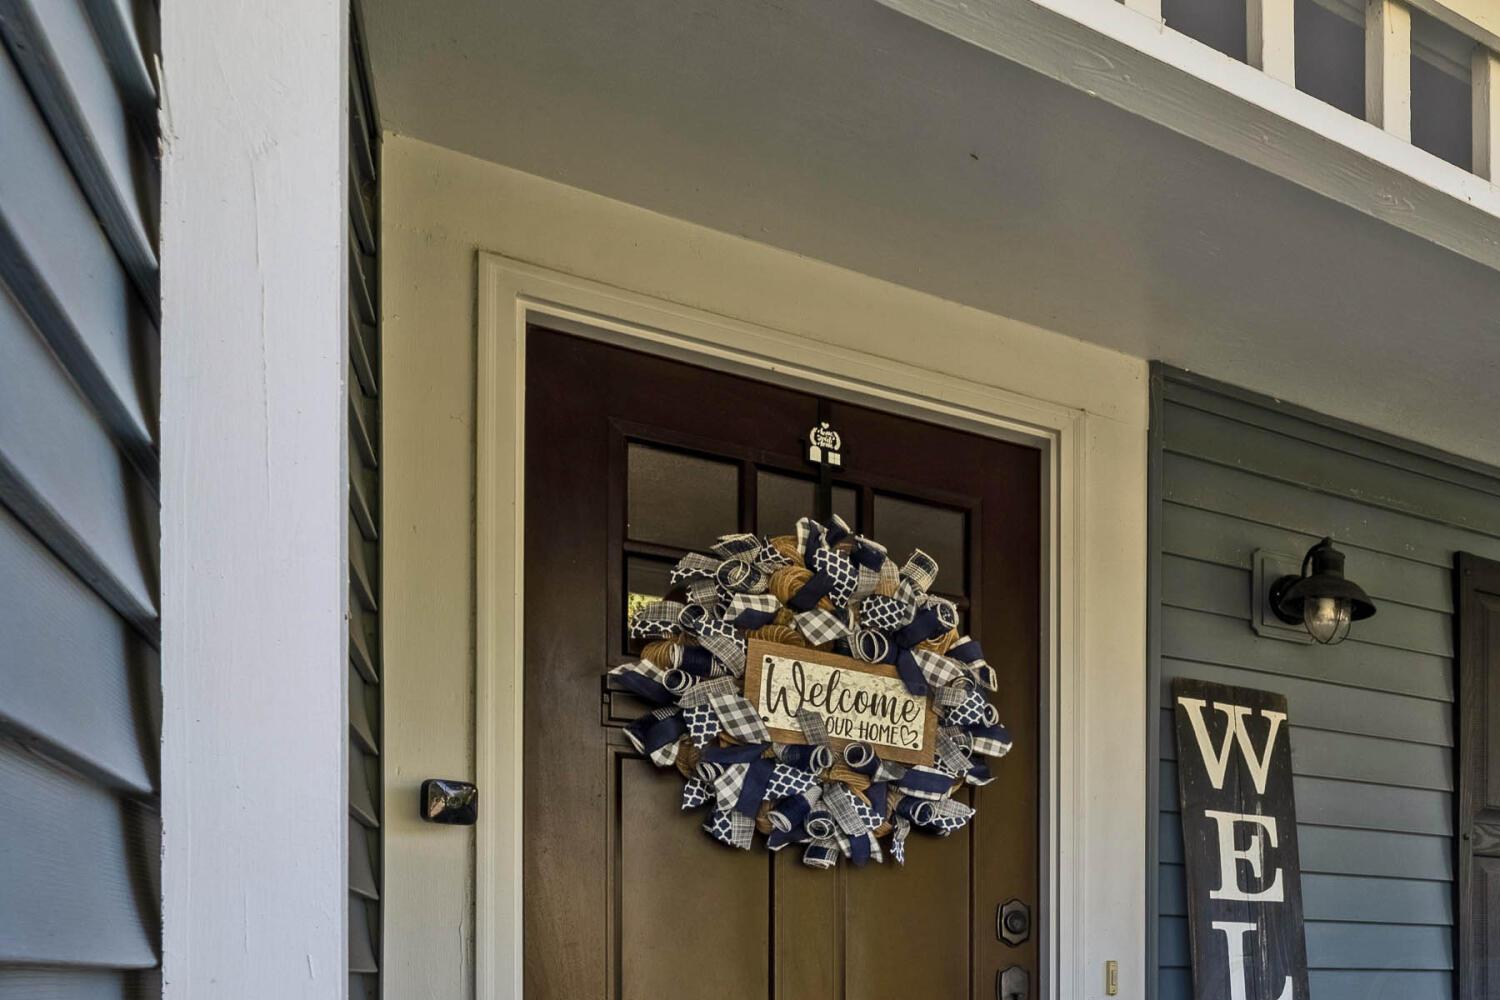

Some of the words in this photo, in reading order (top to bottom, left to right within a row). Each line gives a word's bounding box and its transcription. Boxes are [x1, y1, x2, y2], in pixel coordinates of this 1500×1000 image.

[765, 661, 921, 725] Welcome
[825, 716, 853, 738] OUR
[859, 721, 900, 745] HOME
